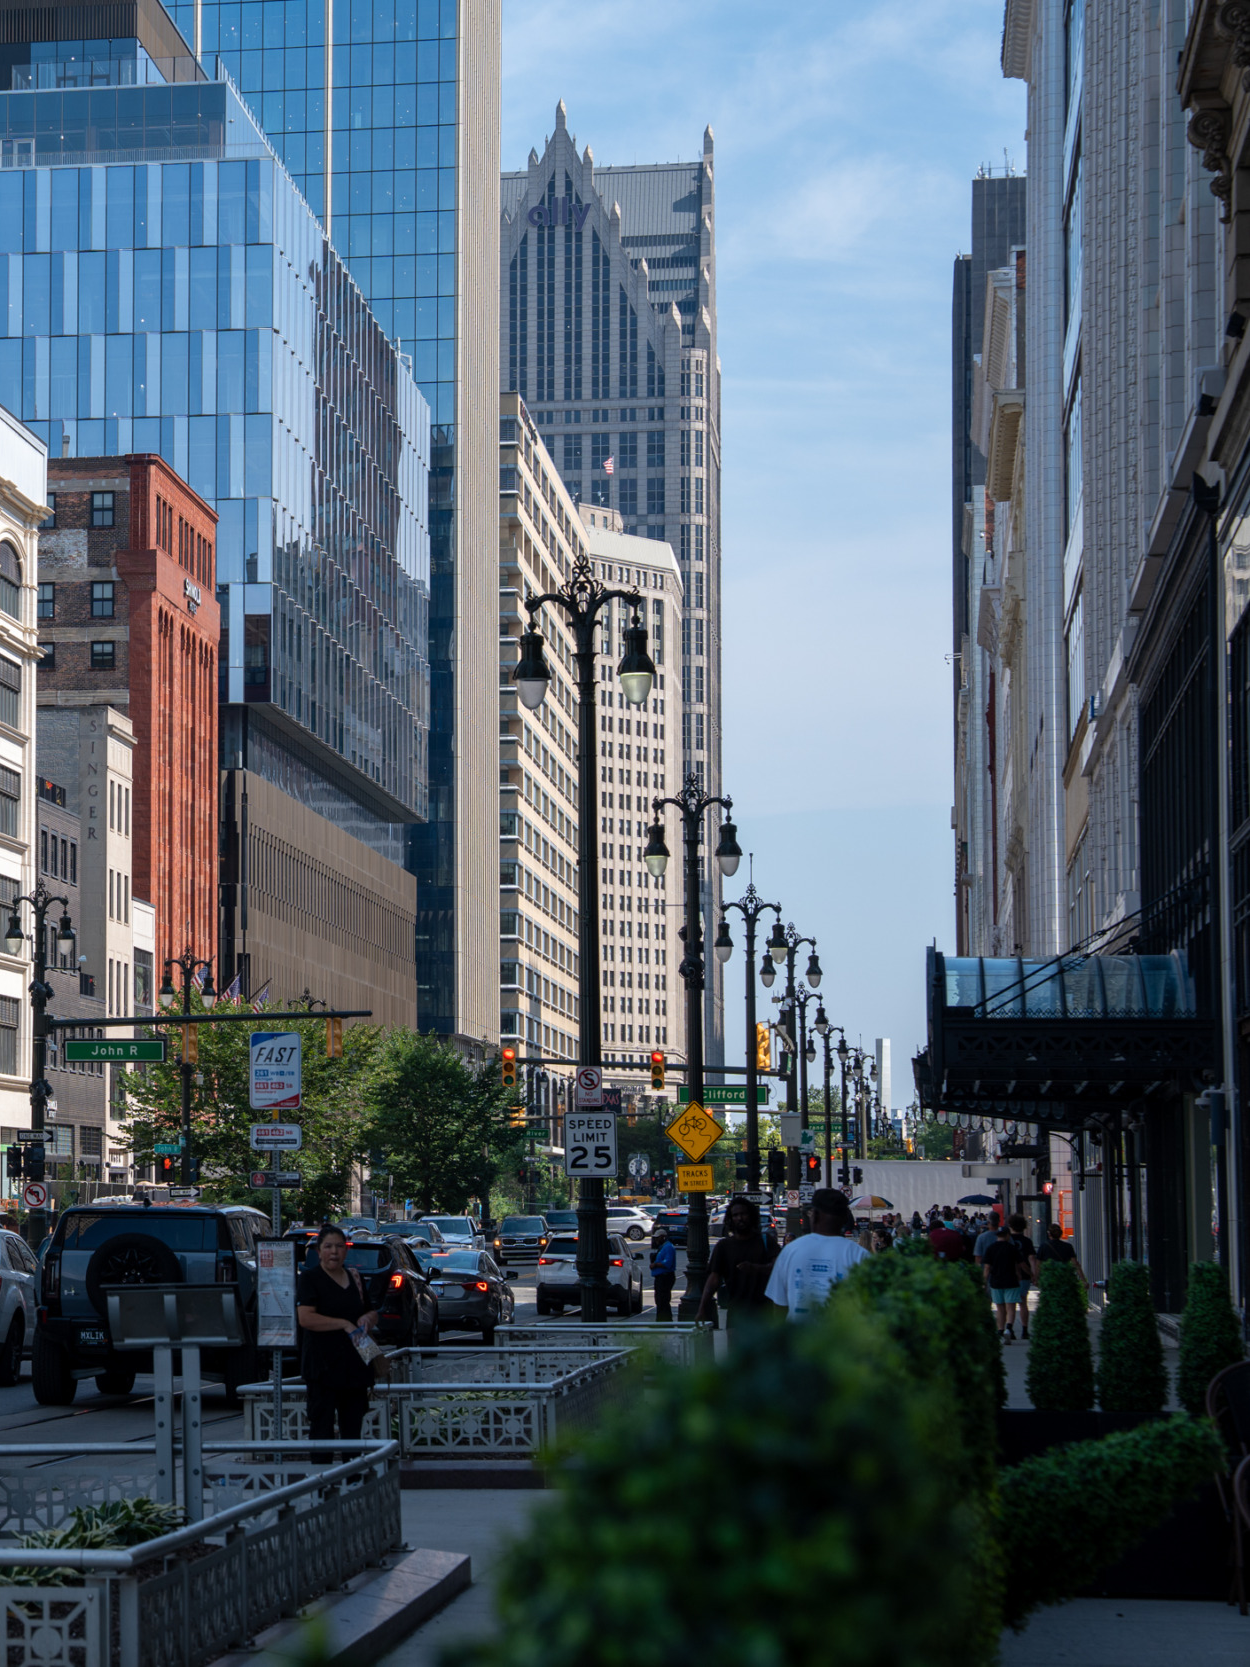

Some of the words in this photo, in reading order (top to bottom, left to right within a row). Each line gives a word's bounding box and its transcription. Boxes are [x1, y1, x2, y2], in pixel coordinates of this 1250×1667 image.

[528, 196, 592, 232] ally
[87, 720, 99, 840] SINGER
[91, 1045, 123, 1055] John
[129, 1045, 138, 1055] R
[255, 1047, 297, 1062] FAST
[602, 1093, 619, 1105] EXAS
[569, 1119, 612, 1129] SPEED
[809, 1123, 825, 1131] rand
[573, 1133, 607, 1142] LIMIT
[570, 1146, 612, 1169] 25
[800, 1191, 813, 1200] 25
